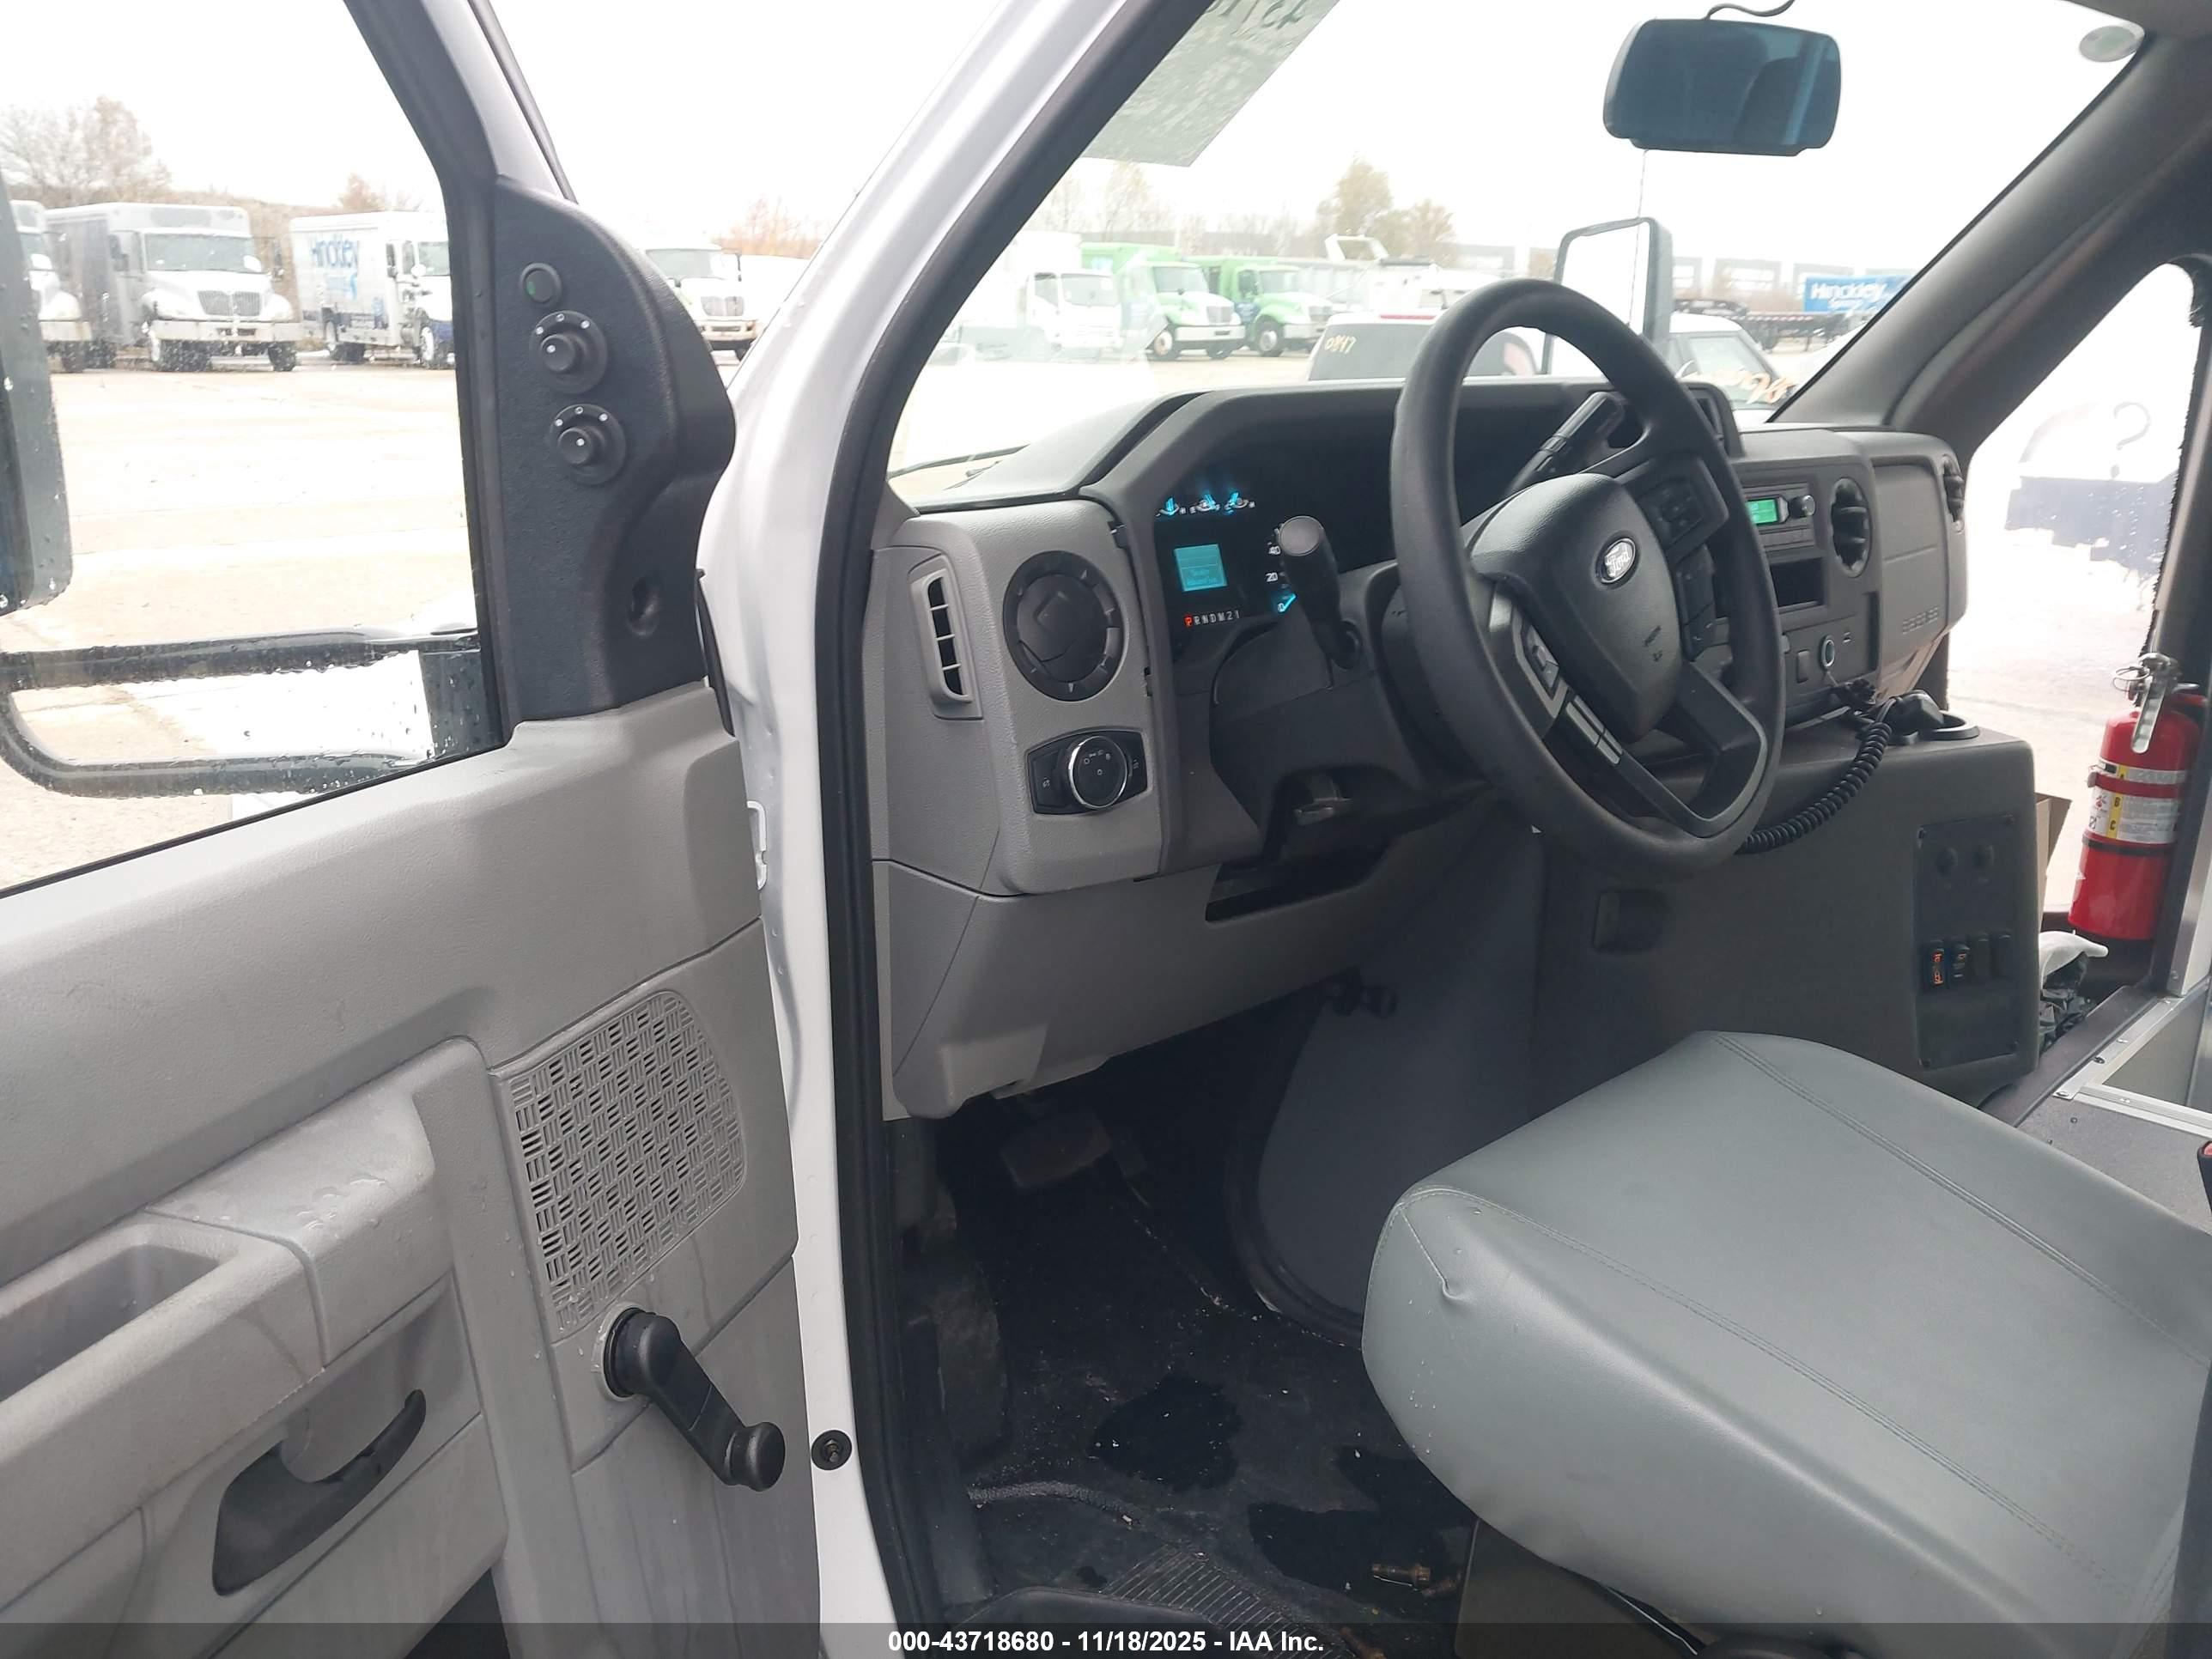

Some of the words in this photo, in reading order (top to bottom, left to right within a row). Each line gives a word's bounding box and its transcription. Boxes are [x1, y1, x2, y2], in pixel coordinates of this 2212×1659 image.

[1265, 572, 1279, 583] 20
[2113, 796, 2121, 808] B
[2109, 819, 2117, 830] C
